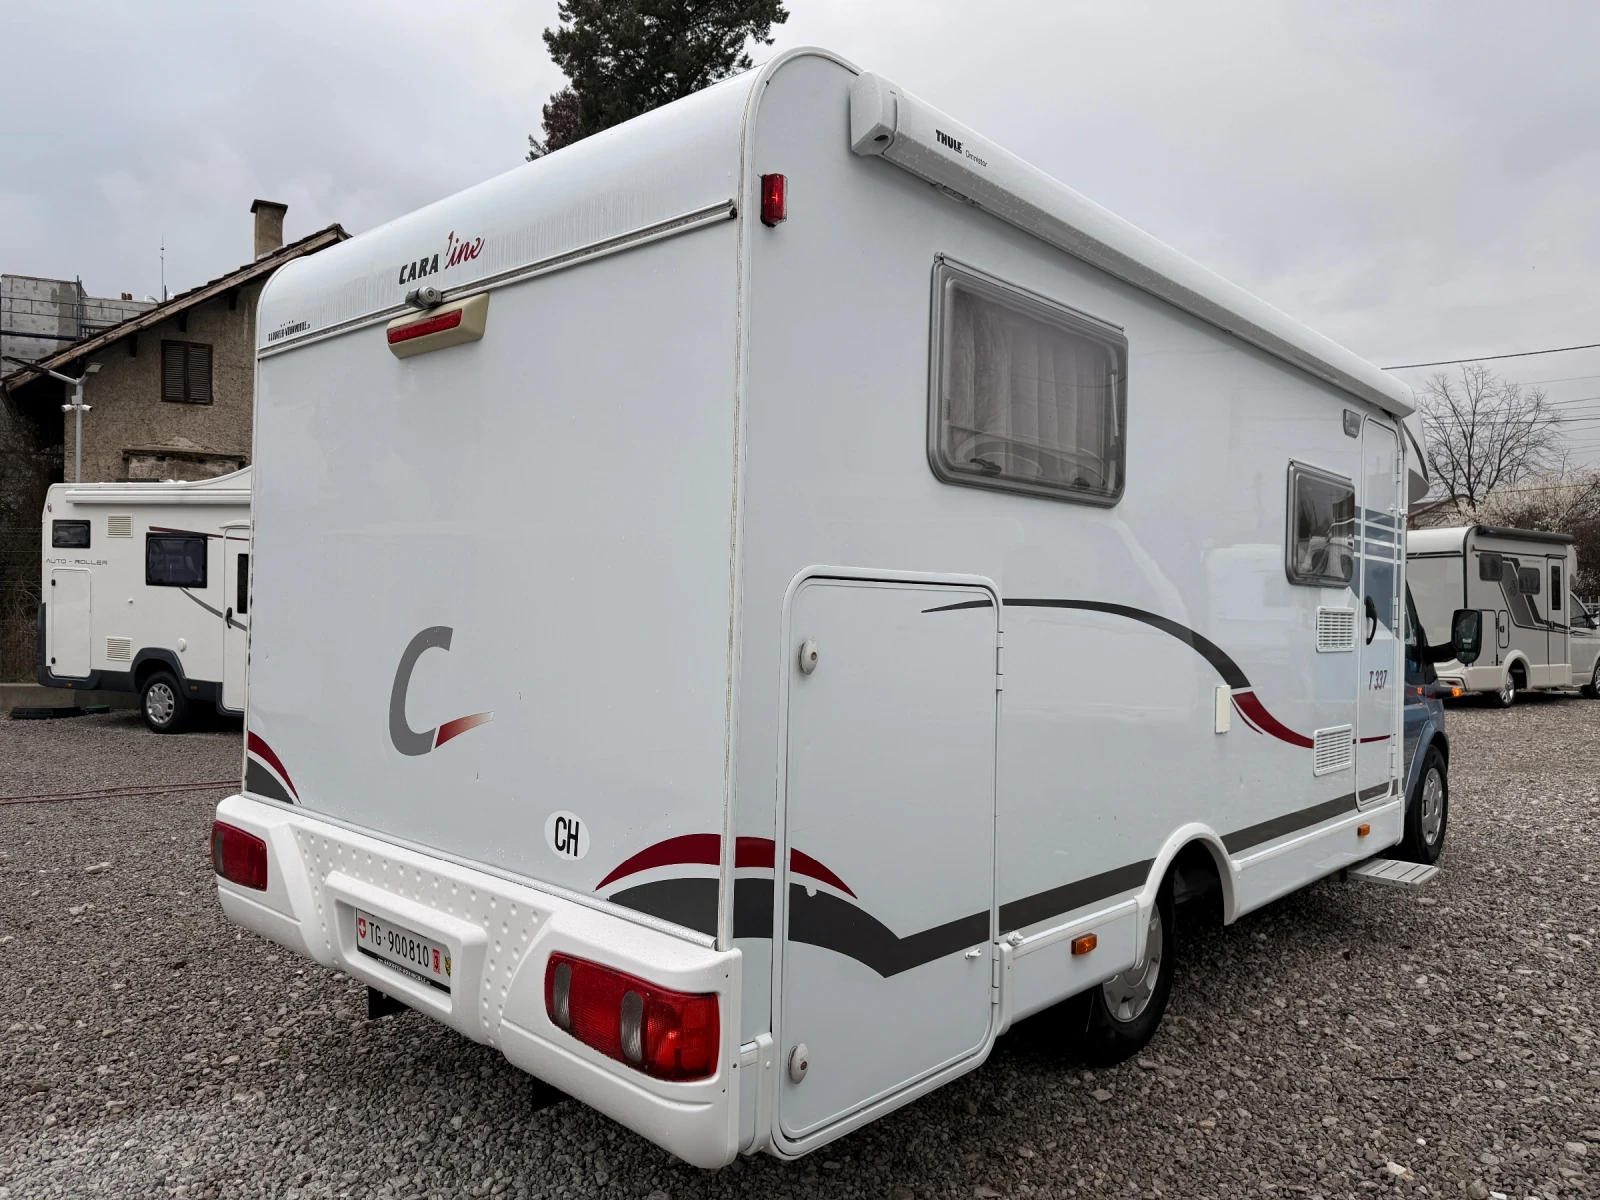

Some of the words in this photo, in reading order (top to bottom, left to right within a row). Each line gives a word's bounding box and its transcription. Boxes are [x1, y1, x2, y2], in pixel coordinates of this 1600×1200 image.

[936, 129, 962, 154] THULE
[399, 253, 439, 285] CARA
[1369, 670, 1375, 691] T
[1374, 669, 1388, 691] 337
[554, 816, 580, 858] CH
